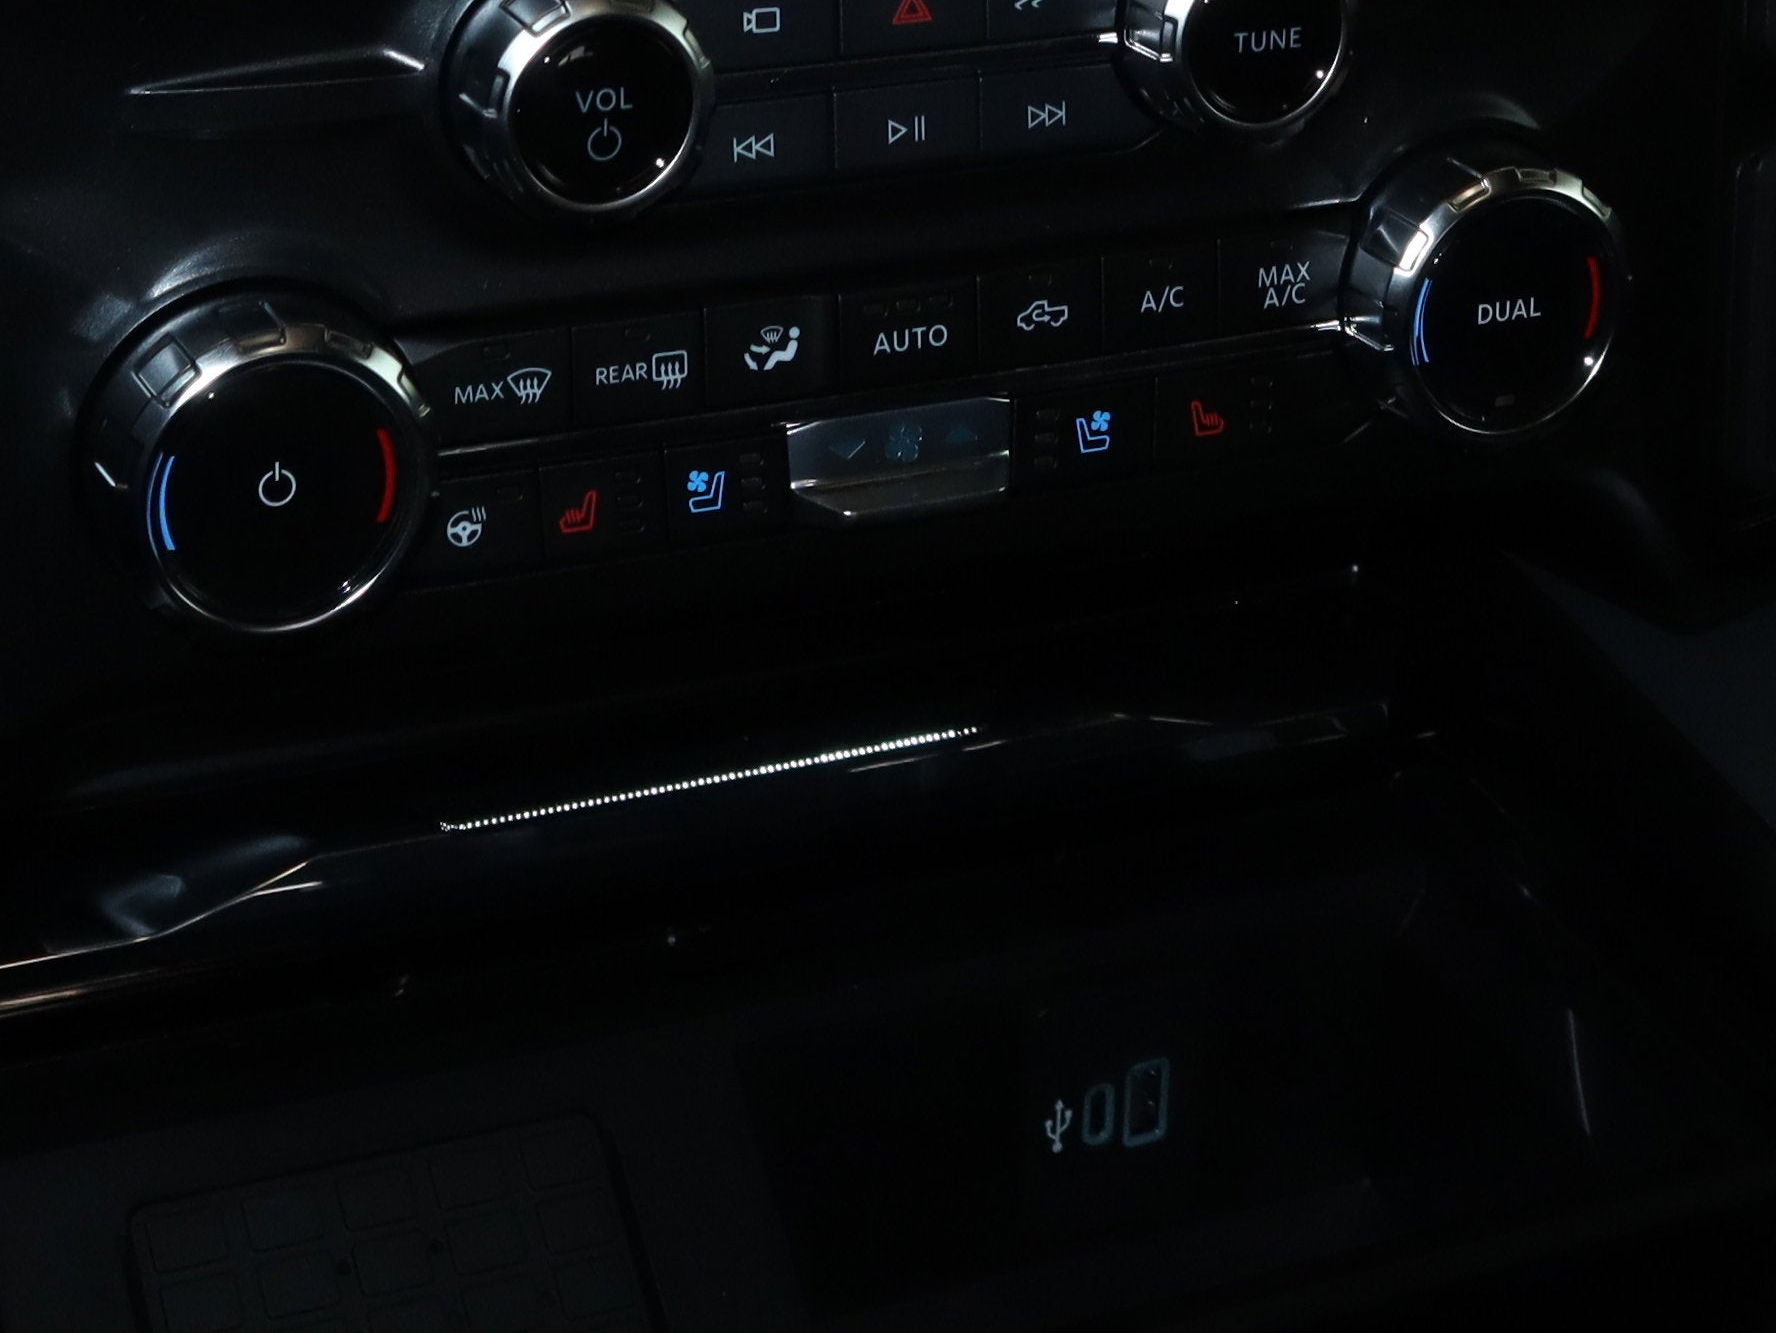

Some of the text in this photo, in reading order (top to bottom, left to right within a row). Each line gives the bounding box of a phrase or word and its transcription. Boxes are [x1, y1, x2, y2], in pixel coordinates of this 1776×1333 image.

[1233, 25, 1303, 54] TUNE
[575, 88, 634, 113] VOL
[1257, 260, 1312, 288] MAX
[1140, 285, 1185, 314] A/C
[1262, 282, 1308, 310] A/C
[1477, 296, 1542, 325] DUAL
[872, 324, 949, 355] AUTO
[594, 360, 649, 386] REAR
[453, 381, 505, 406] MAX
